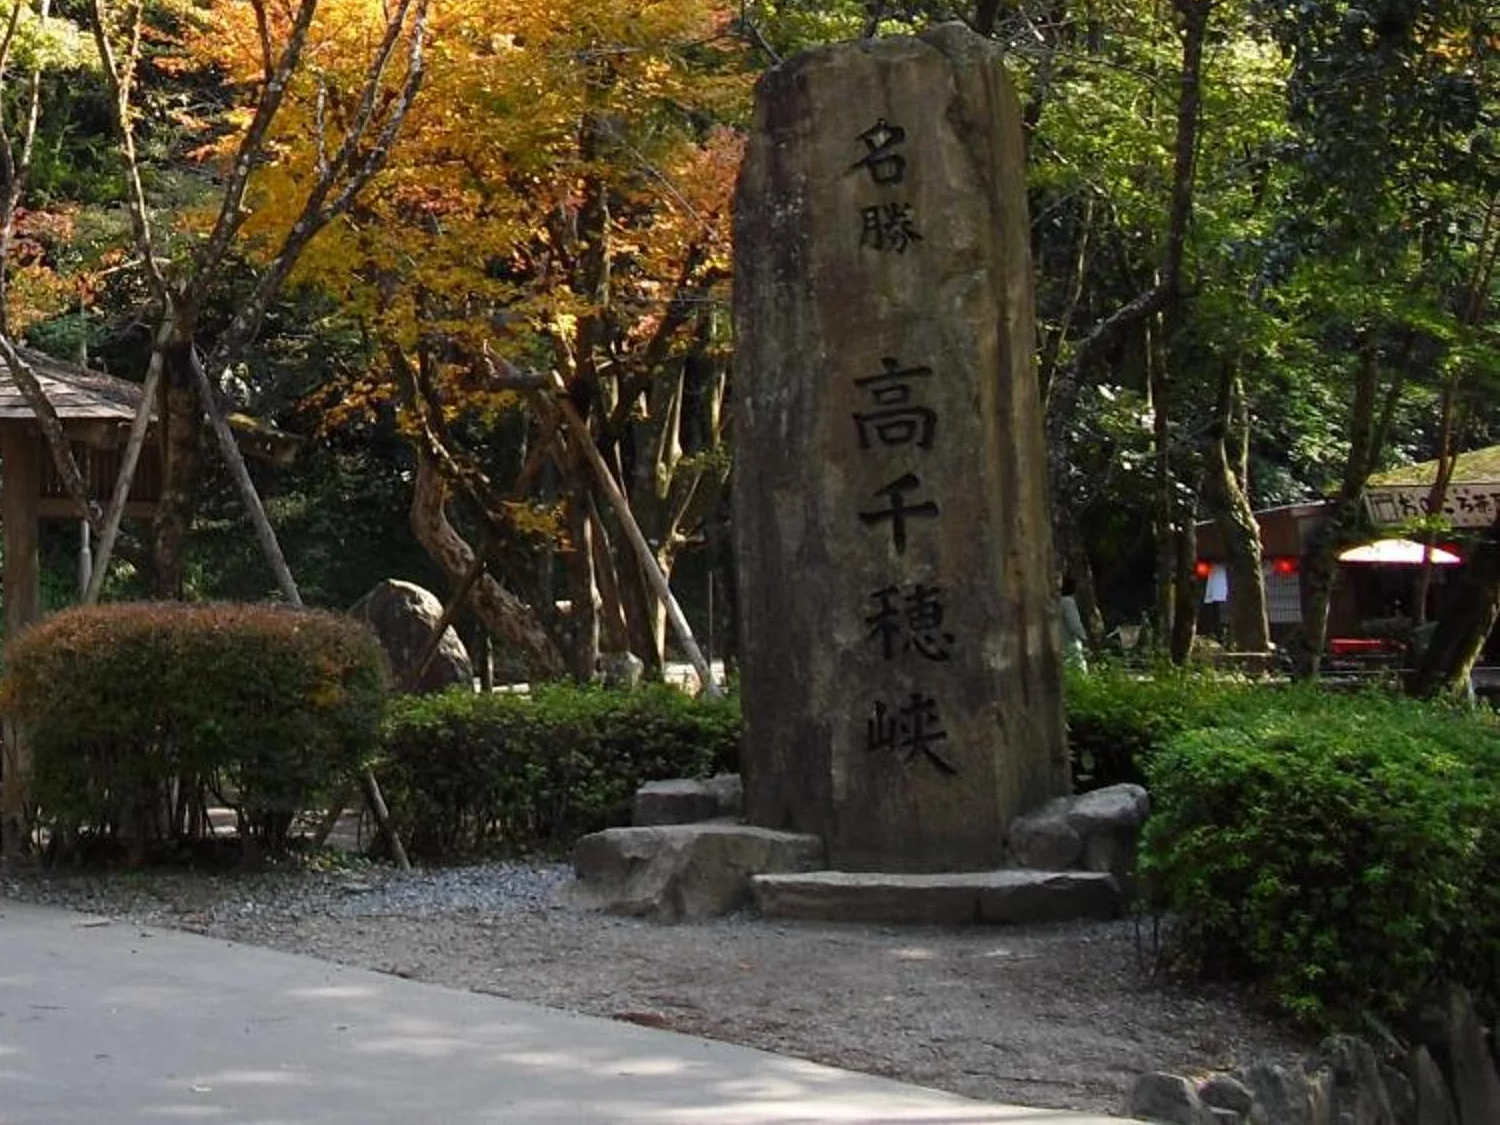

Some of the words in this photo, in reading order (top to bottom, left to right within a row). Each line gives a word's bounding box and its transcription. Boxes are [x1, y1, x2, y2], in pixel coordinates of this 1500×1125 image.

[843, 118, 924, 255] 名勝
[851, 356, 957, 775] 高千穂峡
